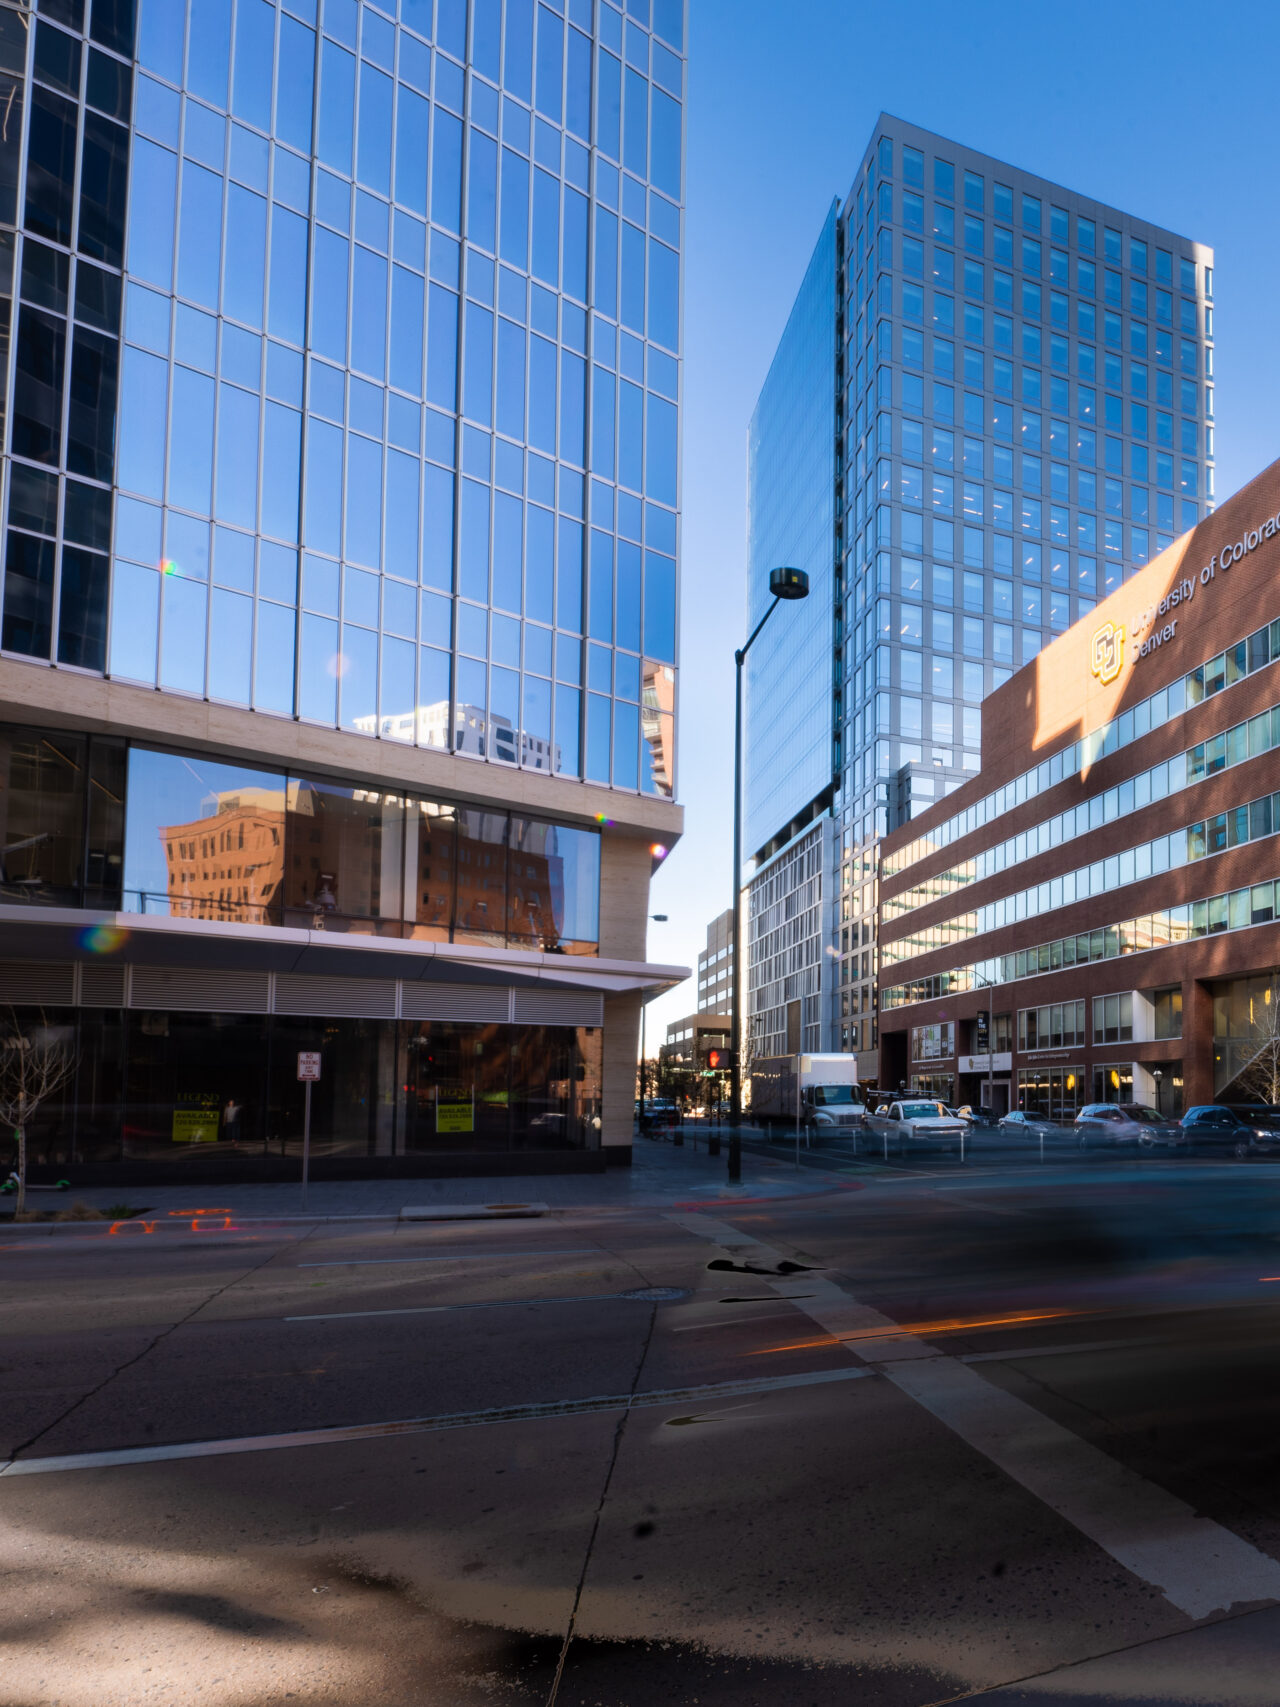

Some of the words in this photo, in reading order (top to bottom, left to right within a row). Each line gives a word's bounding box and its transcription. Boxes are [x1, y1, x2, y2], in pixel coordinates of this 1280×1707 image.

[1131, 575, 1197, 637] University
[1200, 555, 1217, 585] of
[1131, 619, 1178, 665] Denver
